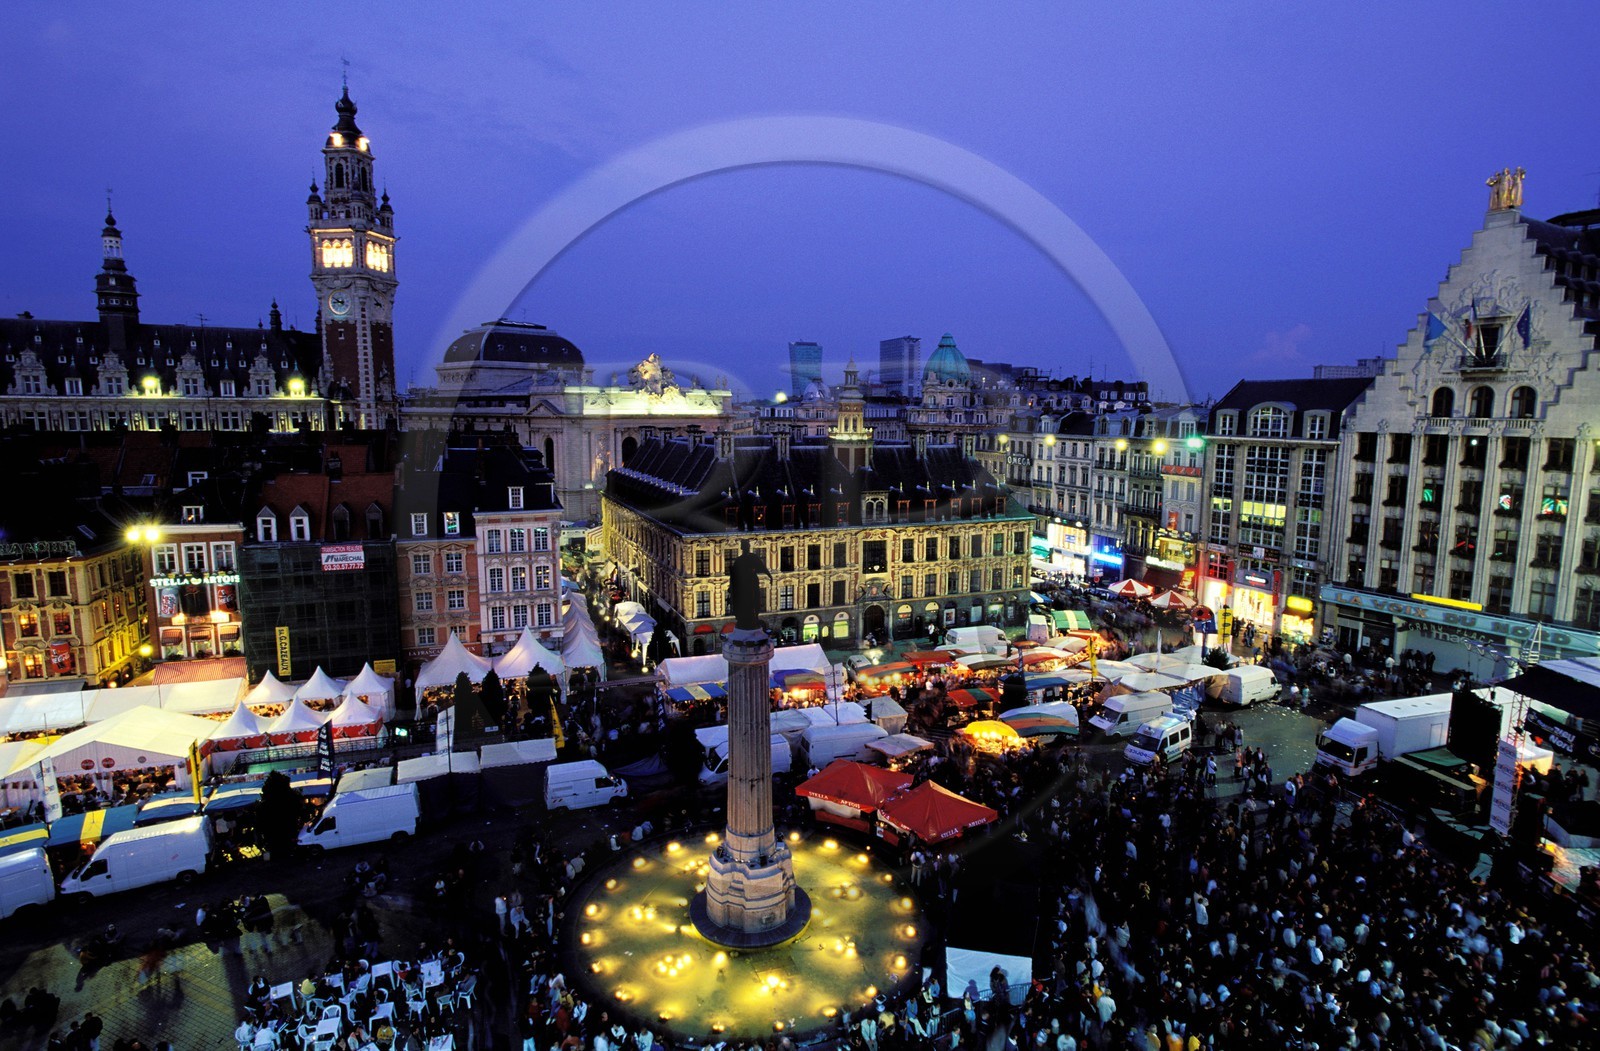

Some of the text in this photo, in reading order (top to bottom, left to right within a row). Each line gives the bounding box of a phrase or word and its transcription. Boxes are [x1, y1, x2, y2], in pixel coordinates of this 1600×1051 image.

[1007, 455, 1031, 466] OMEGA
[149, 574, 241, 587] STELLA ARTOIS
[1335, 592, 1571, 645] LA VOIX DU NORD
[808, 791, 861, 809] STELLA ARTOIS
[940, 827, 959, 839] STELLA
